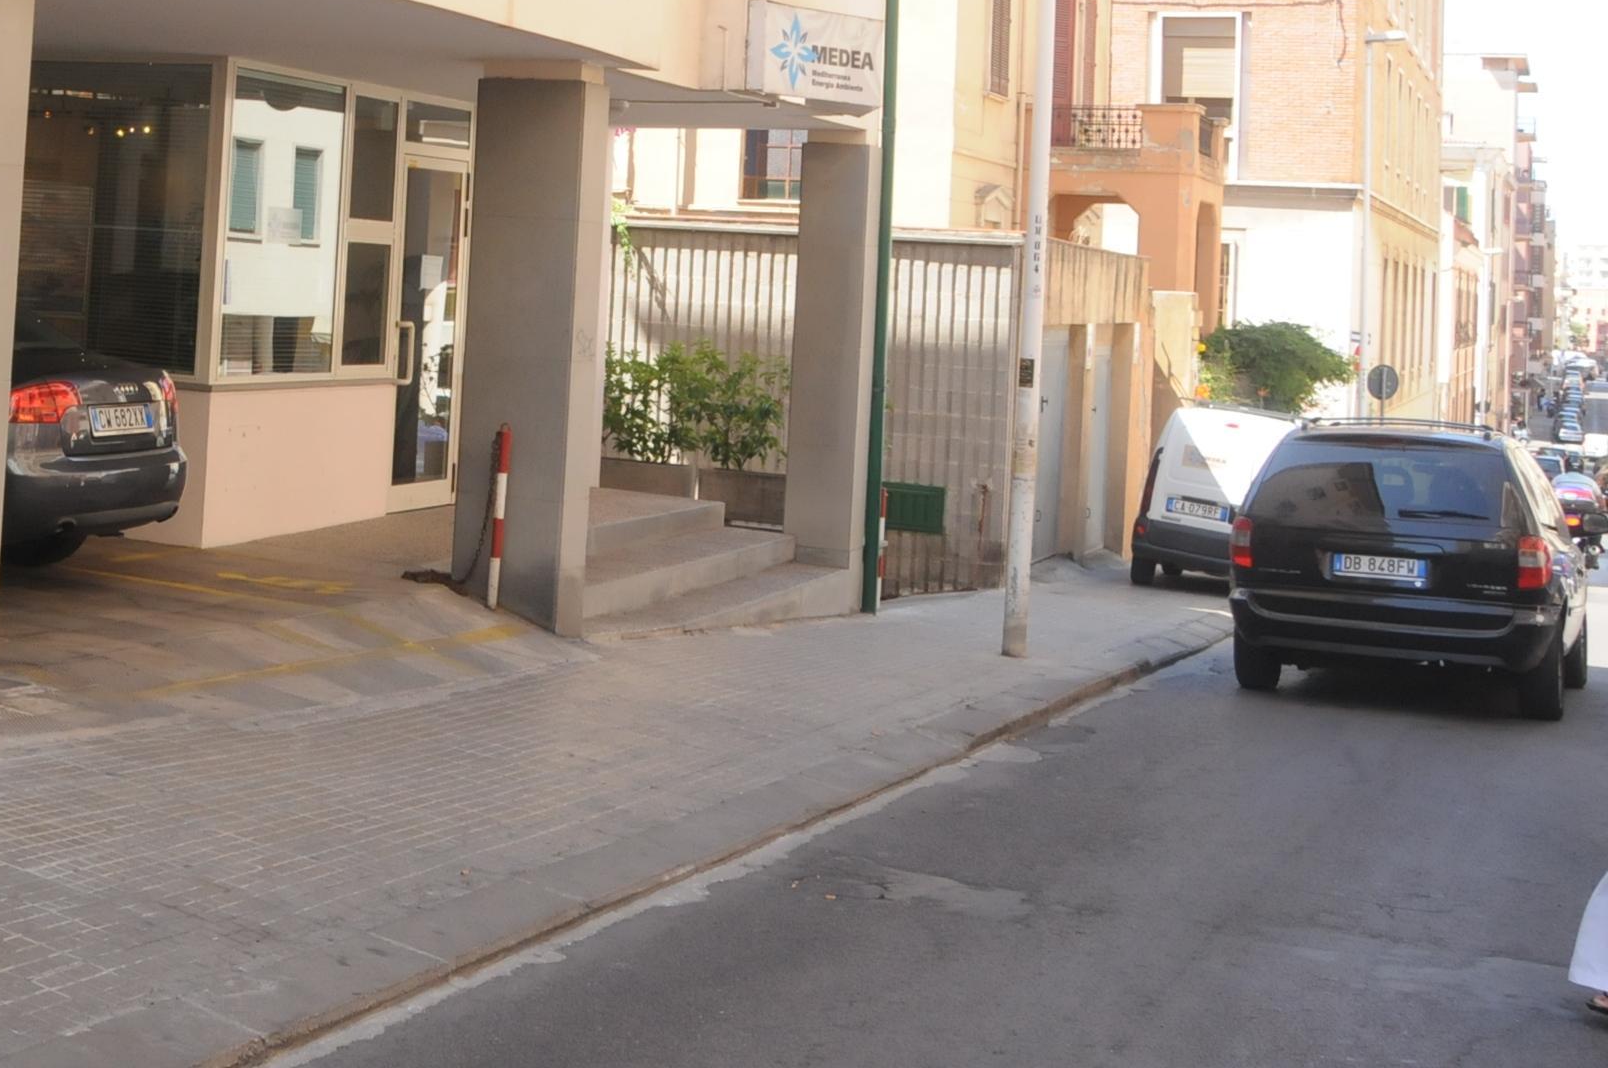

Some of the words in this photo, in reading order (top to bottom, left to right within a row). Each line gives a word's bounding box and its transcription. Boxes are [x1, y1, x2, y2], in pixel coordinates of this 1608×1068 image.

[811, 44, 874, 71] MEDEA
[98, 409, 113, 429] CW
[113, 407, 146, 428] 682XX
[1343, 555, 1362, 571] DB
[1367, 557, 1416, 575] 848FW
